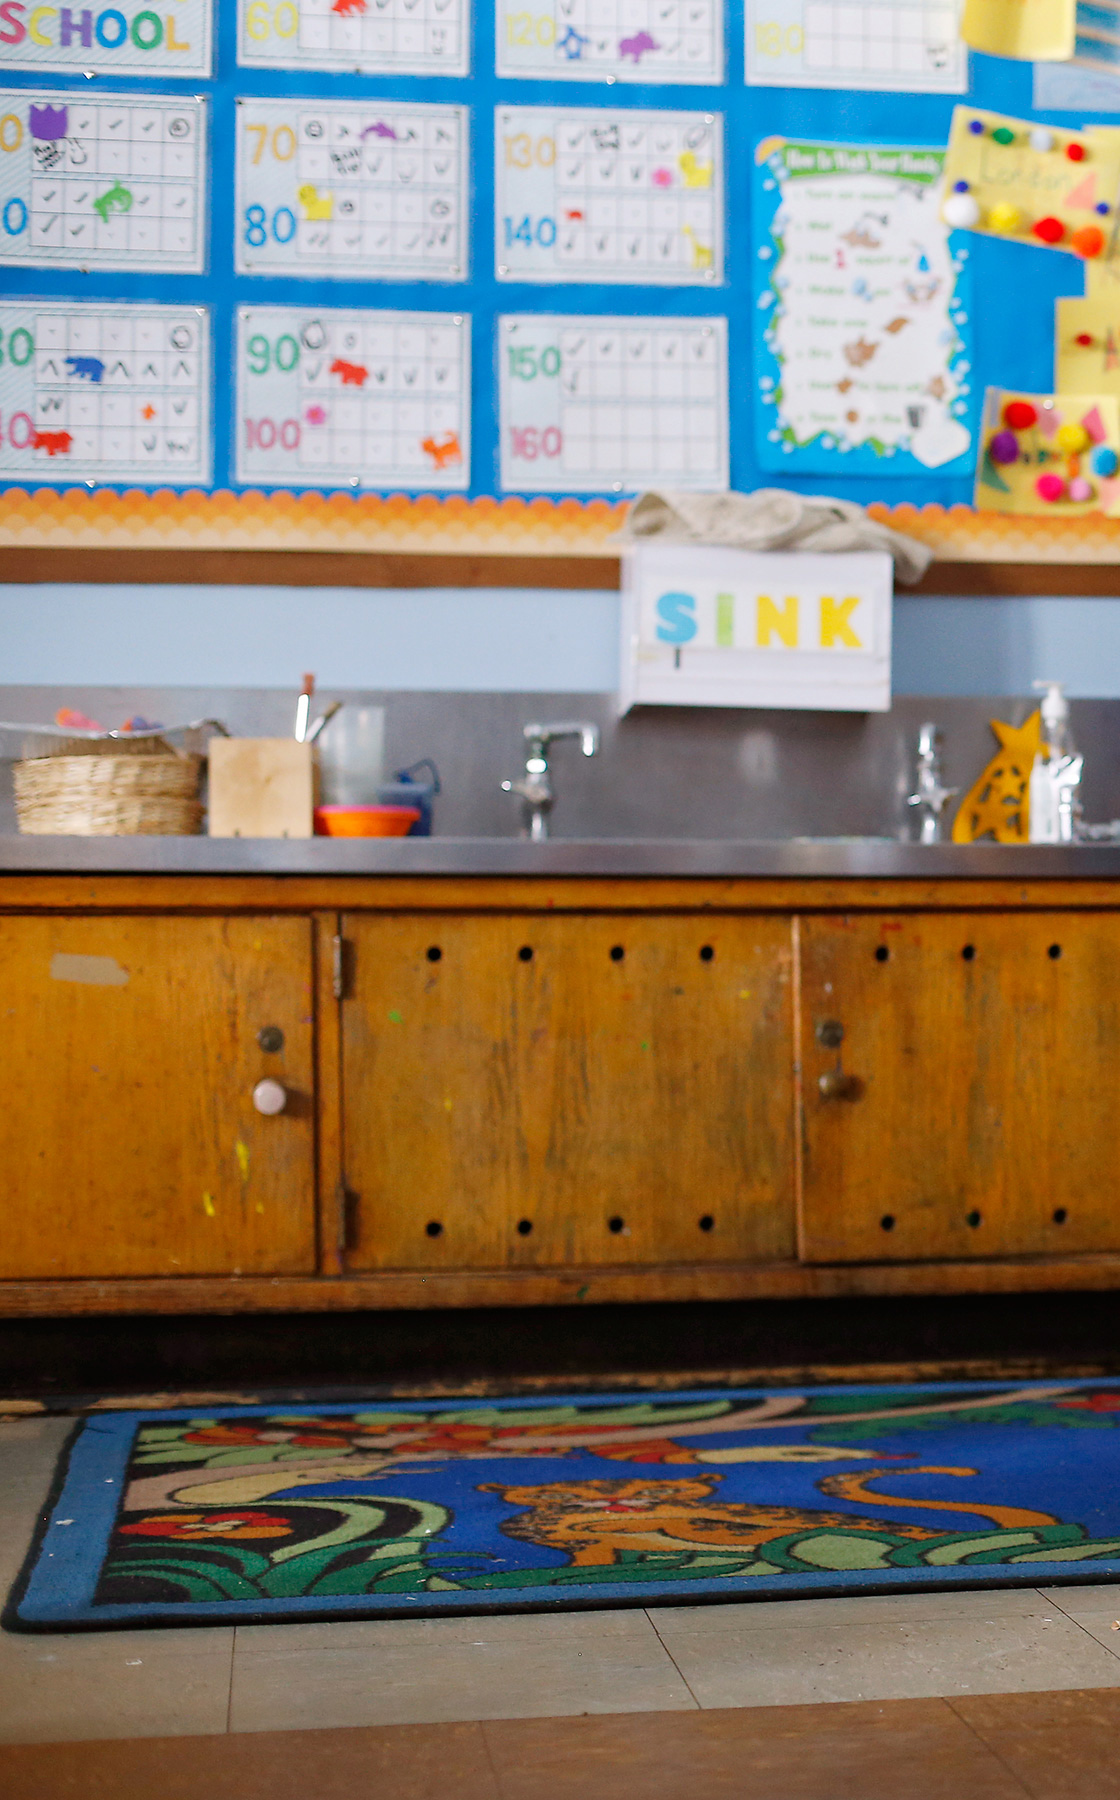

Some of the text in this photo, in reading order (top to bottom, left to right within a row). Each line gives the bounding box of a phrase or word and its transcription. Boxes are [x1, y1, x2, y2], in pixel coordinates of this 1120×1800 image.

[0, 1, 190, 51] SCHOOL
[246, 1, 298, 41] 60
[506, 13, 556, 47] 120
[754, 22, 805, 57] 180
[245, 124, 298, 165] 70
[503, 133, 557, 169] 130
[244, 204, 298, 247] 80
[502, 214, 557, 249] 140
[246, 334, 300, 375] 90
[506, 345, 561, 381] 150
[245, 418, 301, 451] 100
[508, 426, 562, 461] 160
[656, 592, 862, 647] SINK
